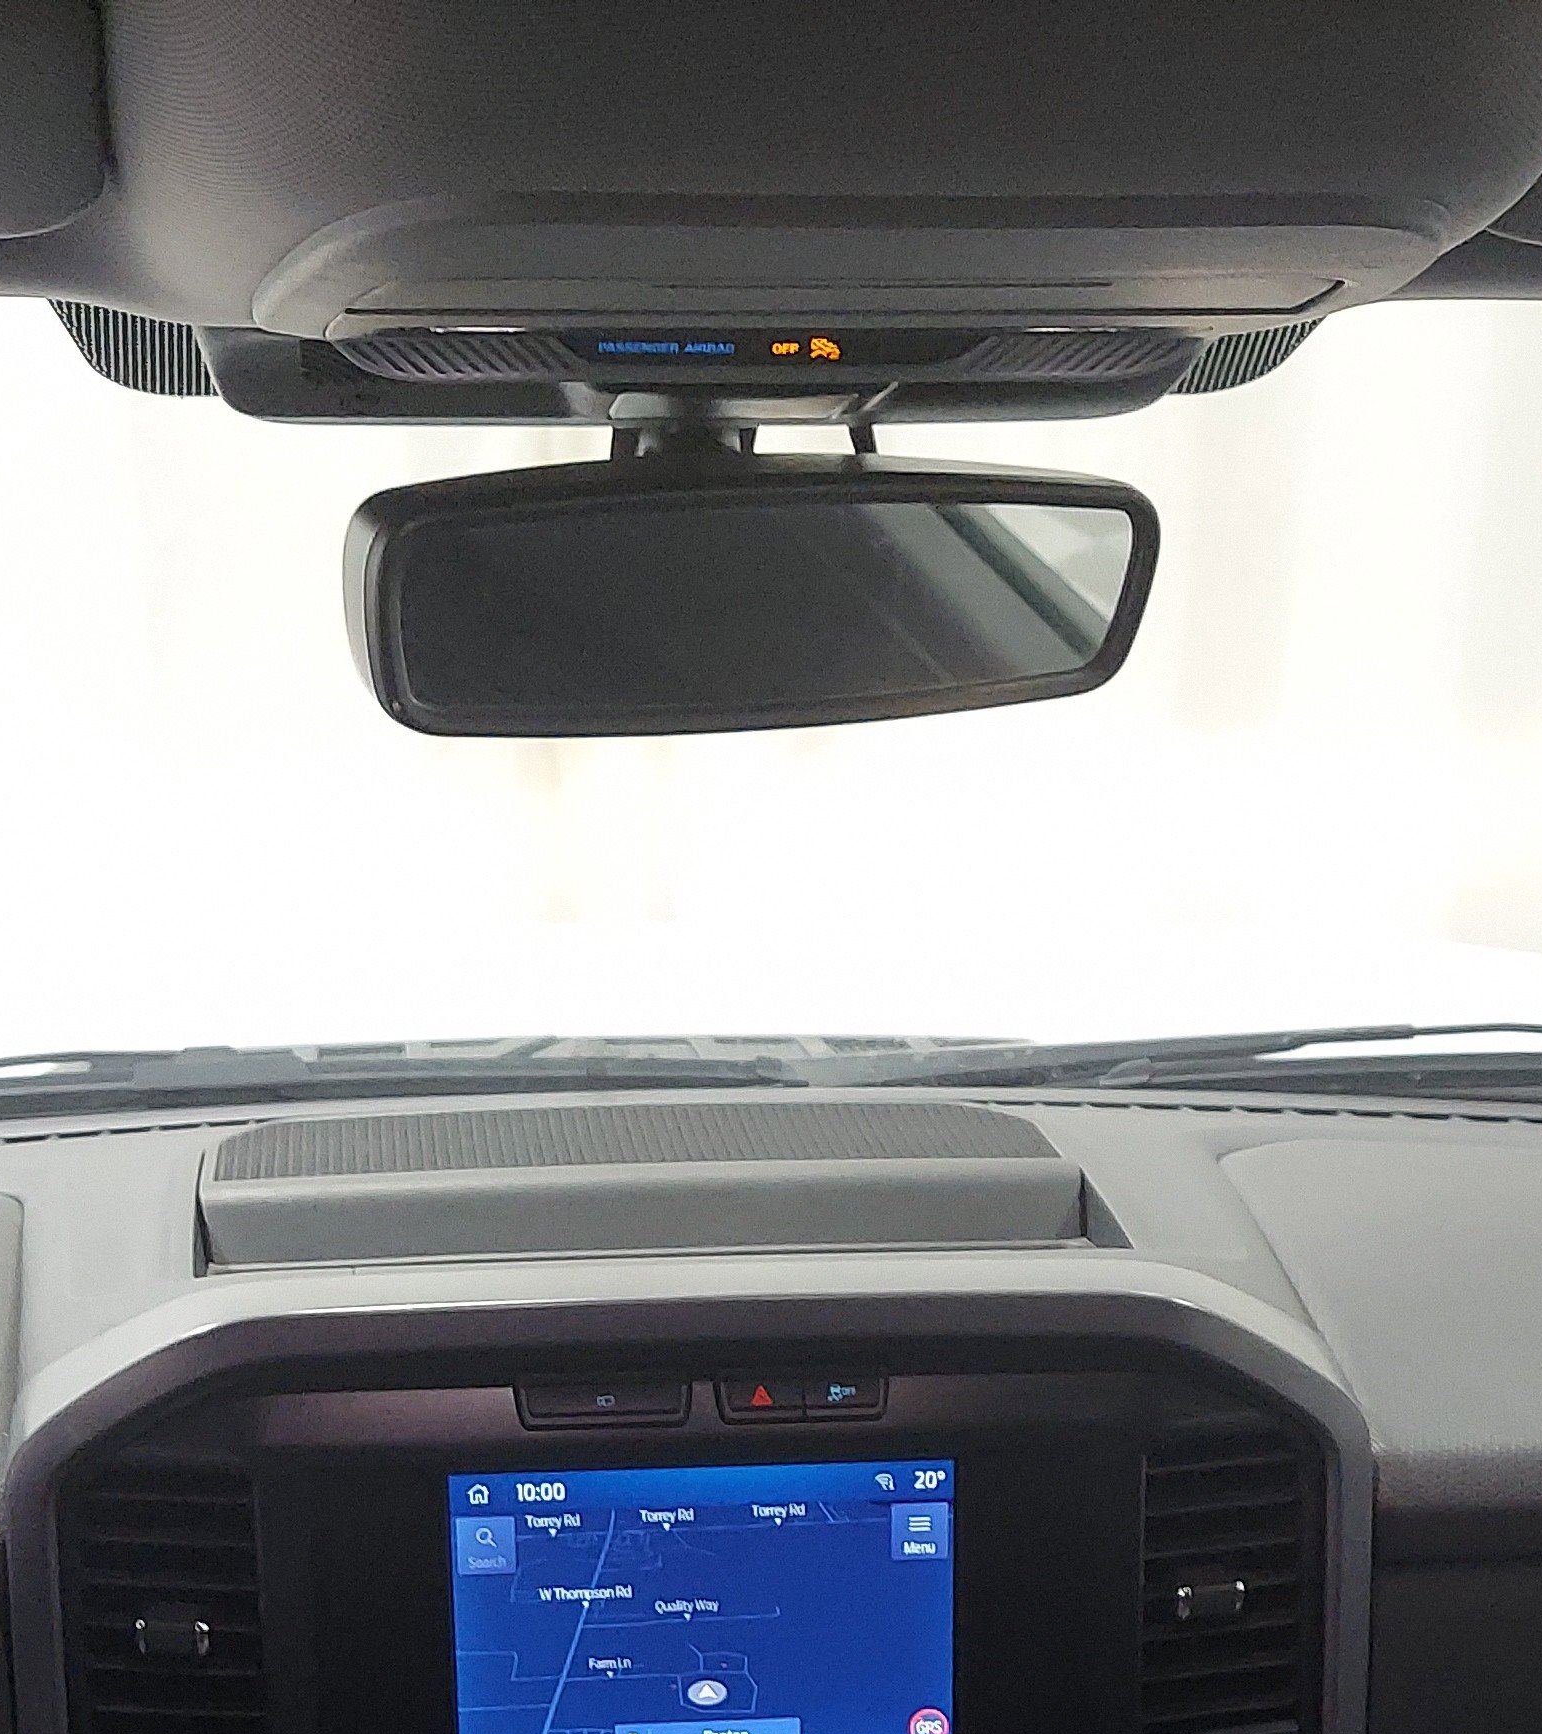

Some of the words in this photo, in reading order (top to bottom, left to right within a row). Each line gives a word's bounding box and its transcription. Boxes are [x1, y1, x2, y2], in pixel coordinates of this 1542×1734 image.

[771, 342, 799, 354] OFF
[913, 1470, 946, 1490] 20°
[516, 1482, 566, 1502] 10:00
[639, 1508, 675, 1524] Torrey
[677, 1507, 695, 1522] Rd
[751, 1504, 787, 1518] Torrey
[789, 1503, 806, 1517] Rd
[525, 1514, 562, 1530] Torrey
[563, 1513, 581, 1527] Rd
[903, 1541, 937, 1555] Menu
[468, 1555, 507, 1570] Search
[539, 1587, 552, 1601] W
[553, 1586, 615, 1601] Thompson
[615, 1585, 632, 1599] Rd
[654, 1599, 694, 1615] Quality
[695, 1599, 720, 1612] Way
